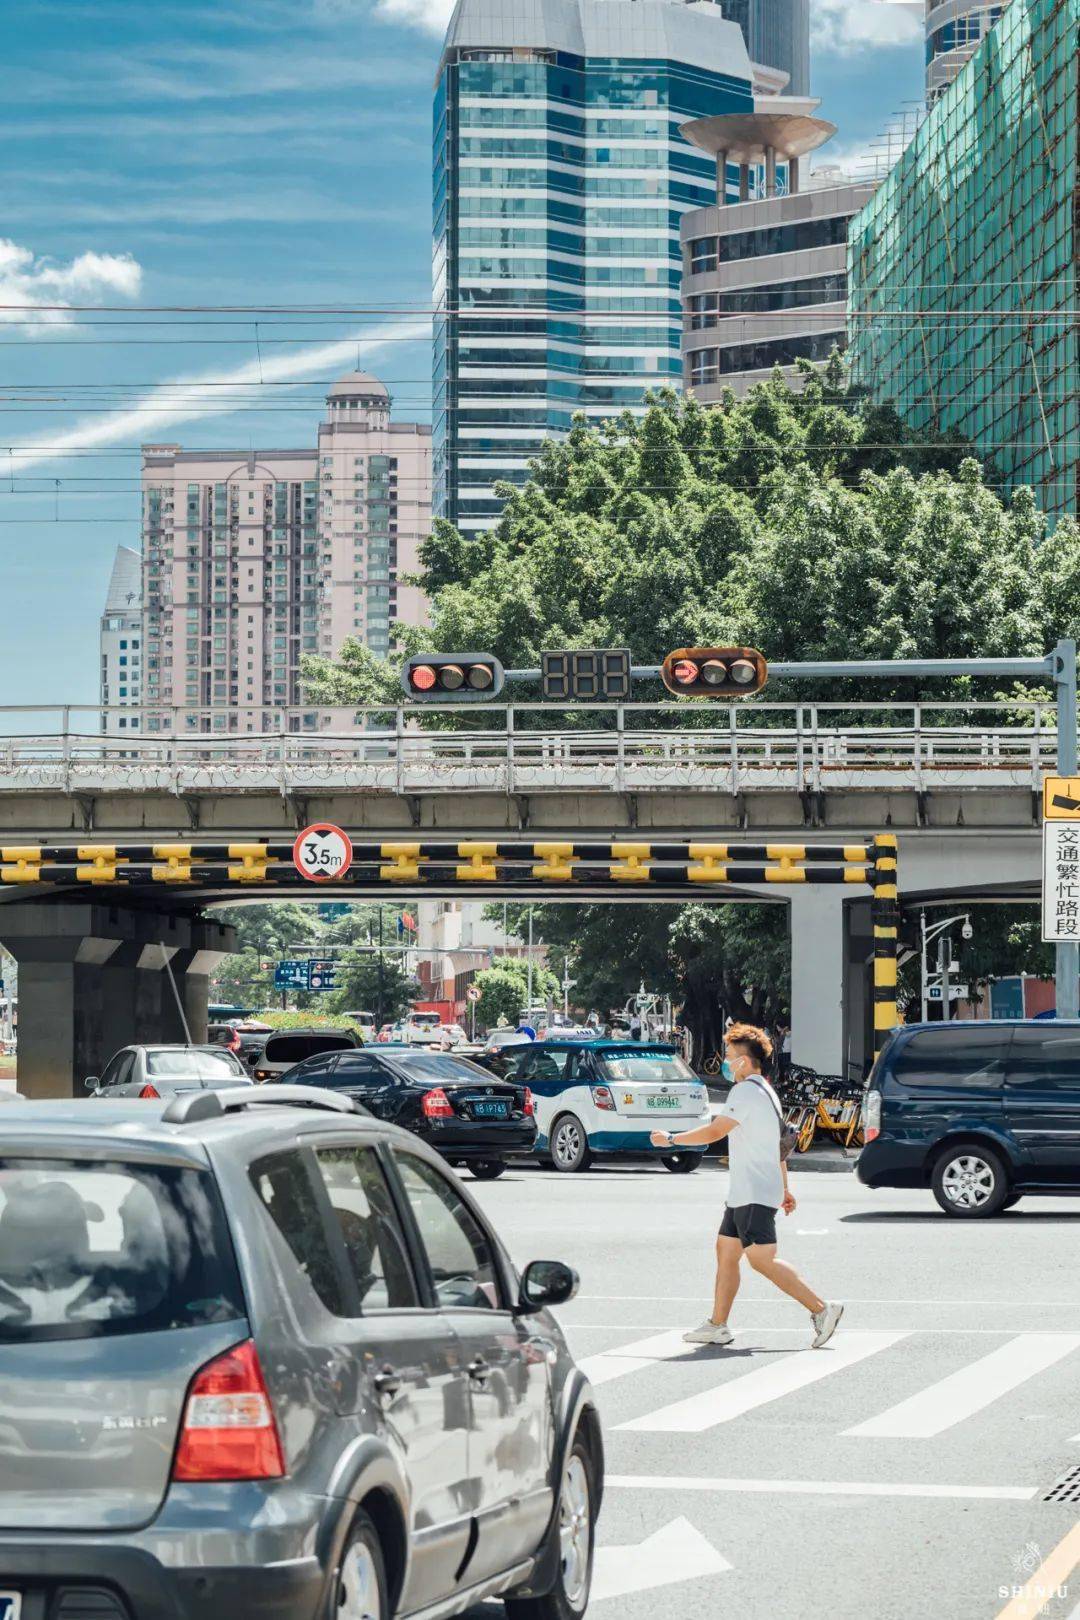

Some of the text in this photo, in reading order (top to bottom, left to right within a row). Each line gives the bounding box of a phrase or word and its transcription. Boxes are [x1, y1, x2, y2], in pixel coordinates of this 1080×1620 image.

[304, 843, 342, 866] 3.5m
[1055, 828, 1080, 935] 交通繁忙路段
